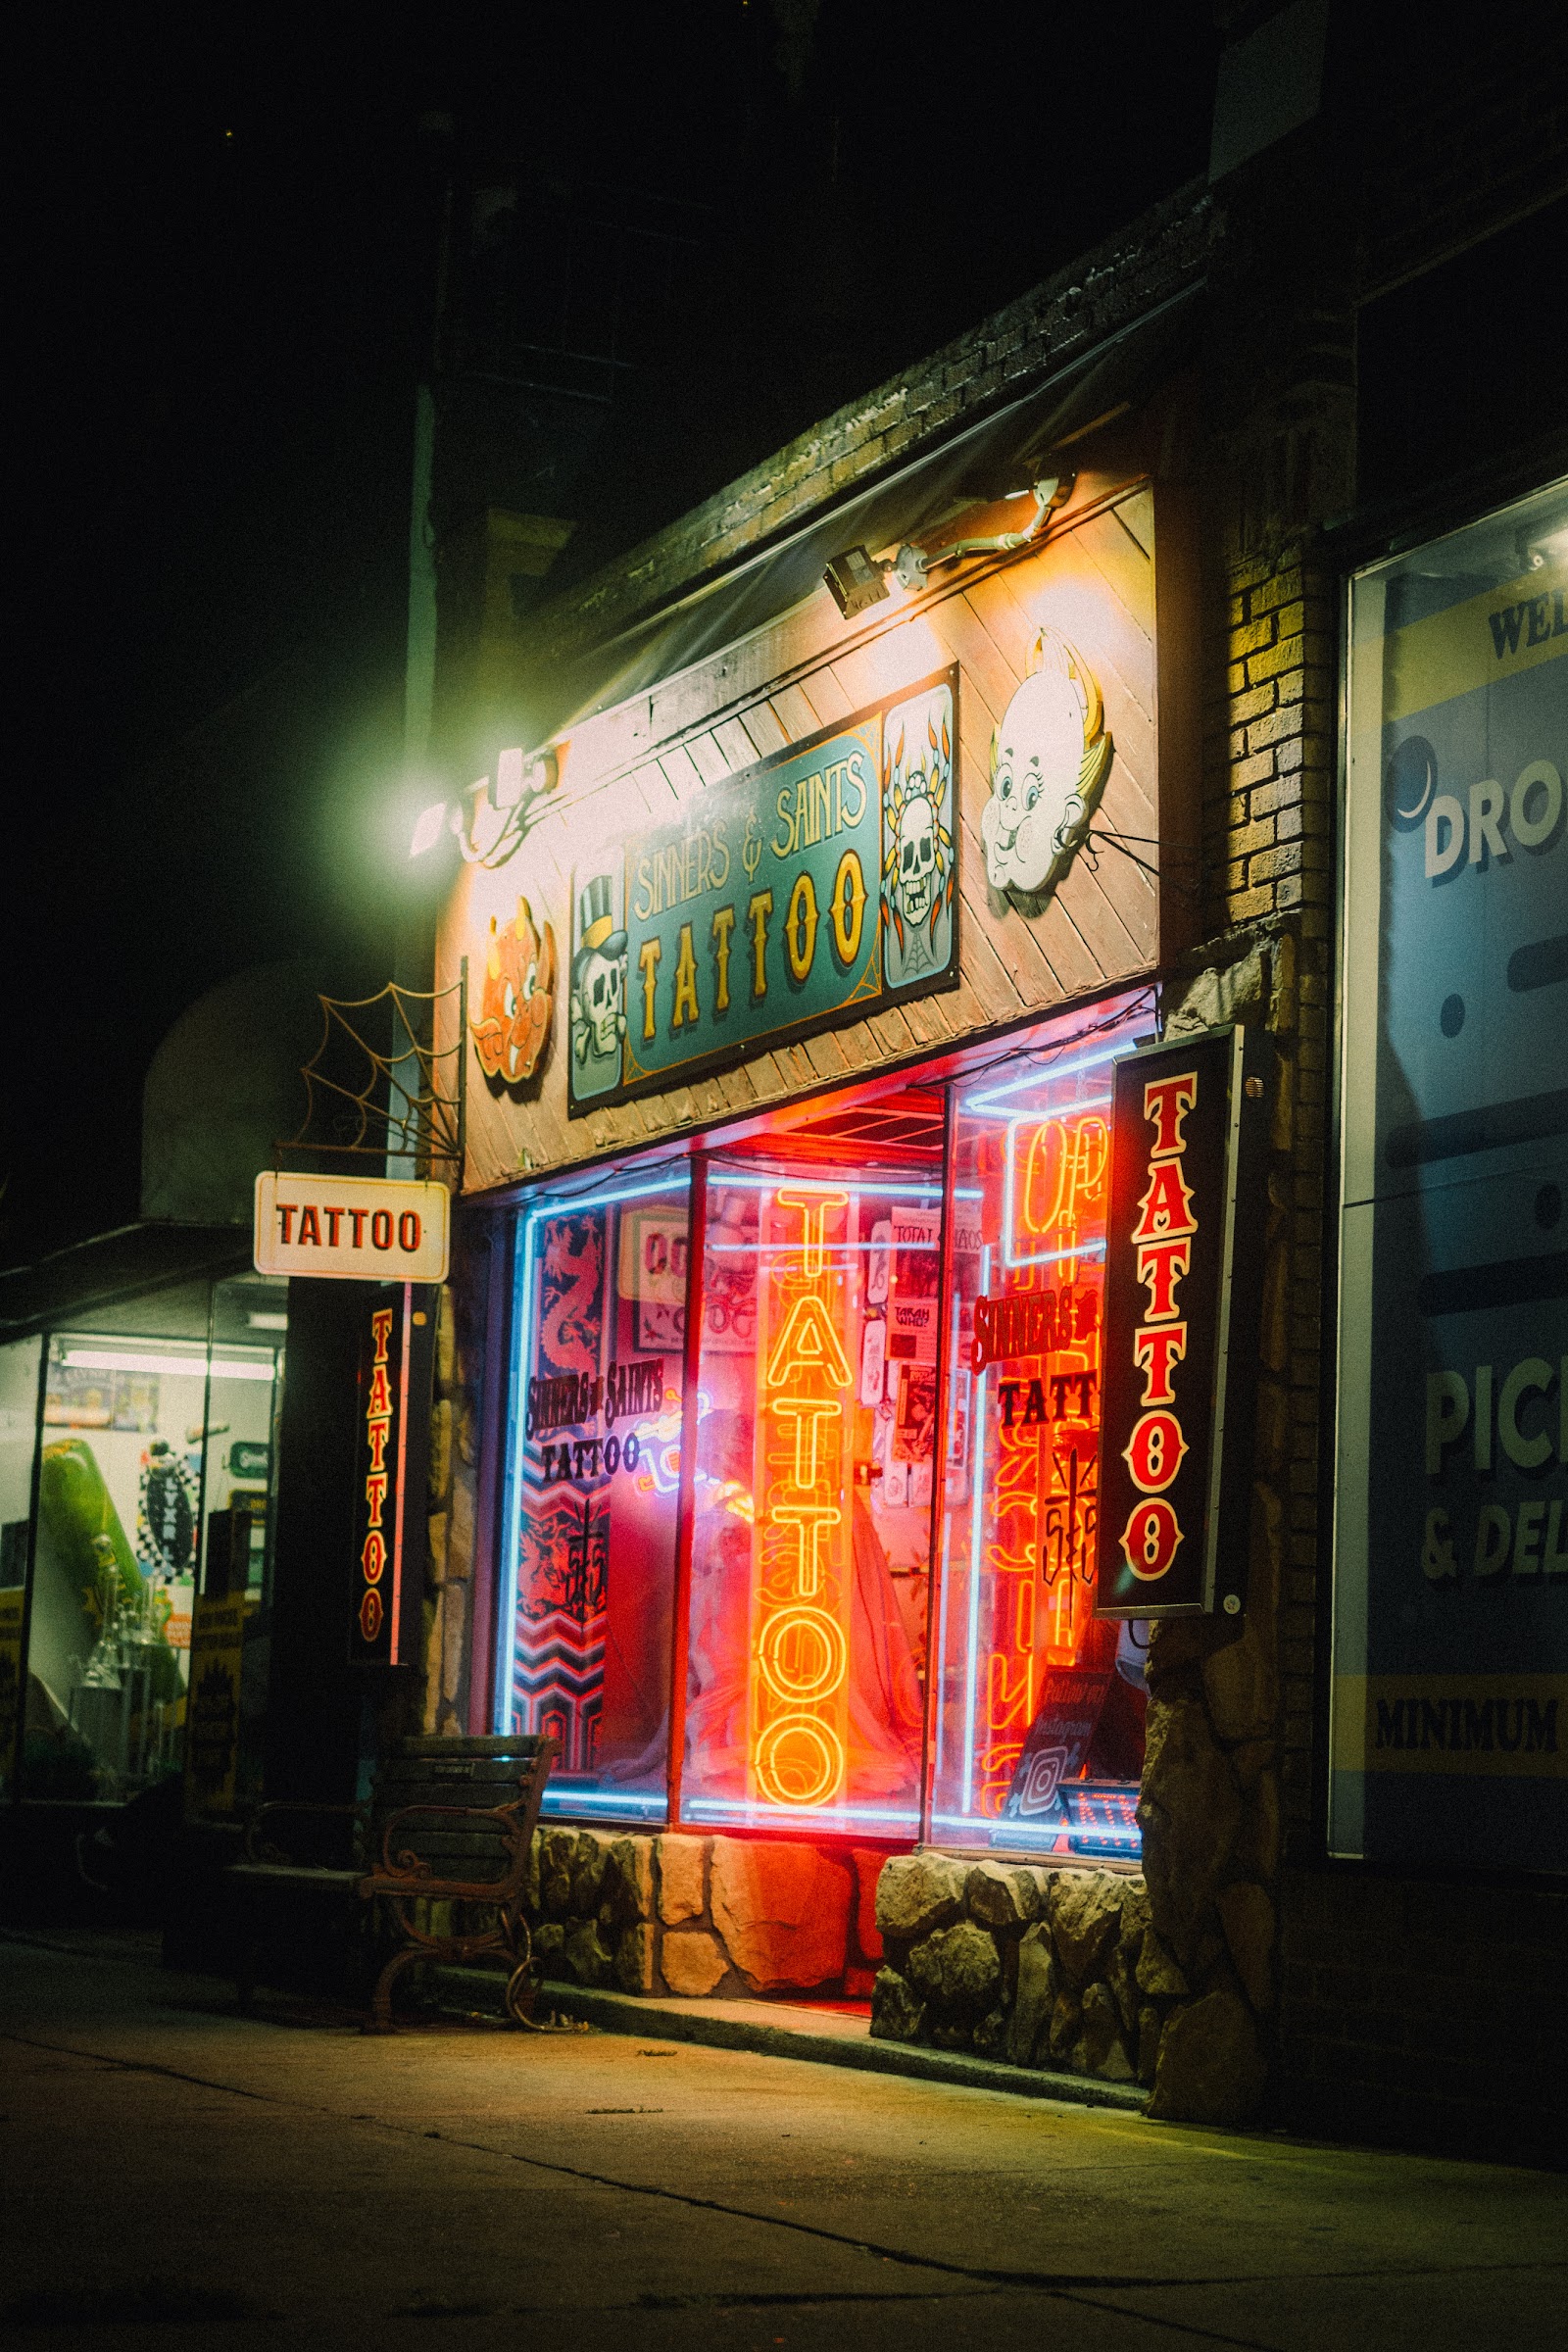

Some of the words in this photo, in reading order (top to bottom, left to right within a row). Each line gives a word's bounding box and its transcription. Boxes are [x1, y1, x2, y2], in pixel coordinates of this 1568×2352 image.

[1488, 587, 1568, 660] WEL
[633, 822, 731, 920] SINNERS
[742, 805, 763, 882] &
[771, 751, 869, 858] SAINTS
[1425, 760, 1565, 885] DRO
[638, 848, 869, 1043] TATTOO
[276, 1203, 422, 1253] TATTOO
[895, 1306, 930, 1319] TARAH
[971, 1286, 1072, 1376] SINNERS
[1118, 1070, 1199, 1582] TATTOO
[605, 1358, 664, 1429] SAINTS
[359, 1308, 393, 1642] TATTOO
[541, 1432, 640, 1483] TATTOO
[756, 1187, 853, 1809] TATTOO
[1421, 1505, 1457, 1580] &
[1474, 1499, 1568, 1577] DEL
[1376, 1697, 1559, 1753] MINIMUM
